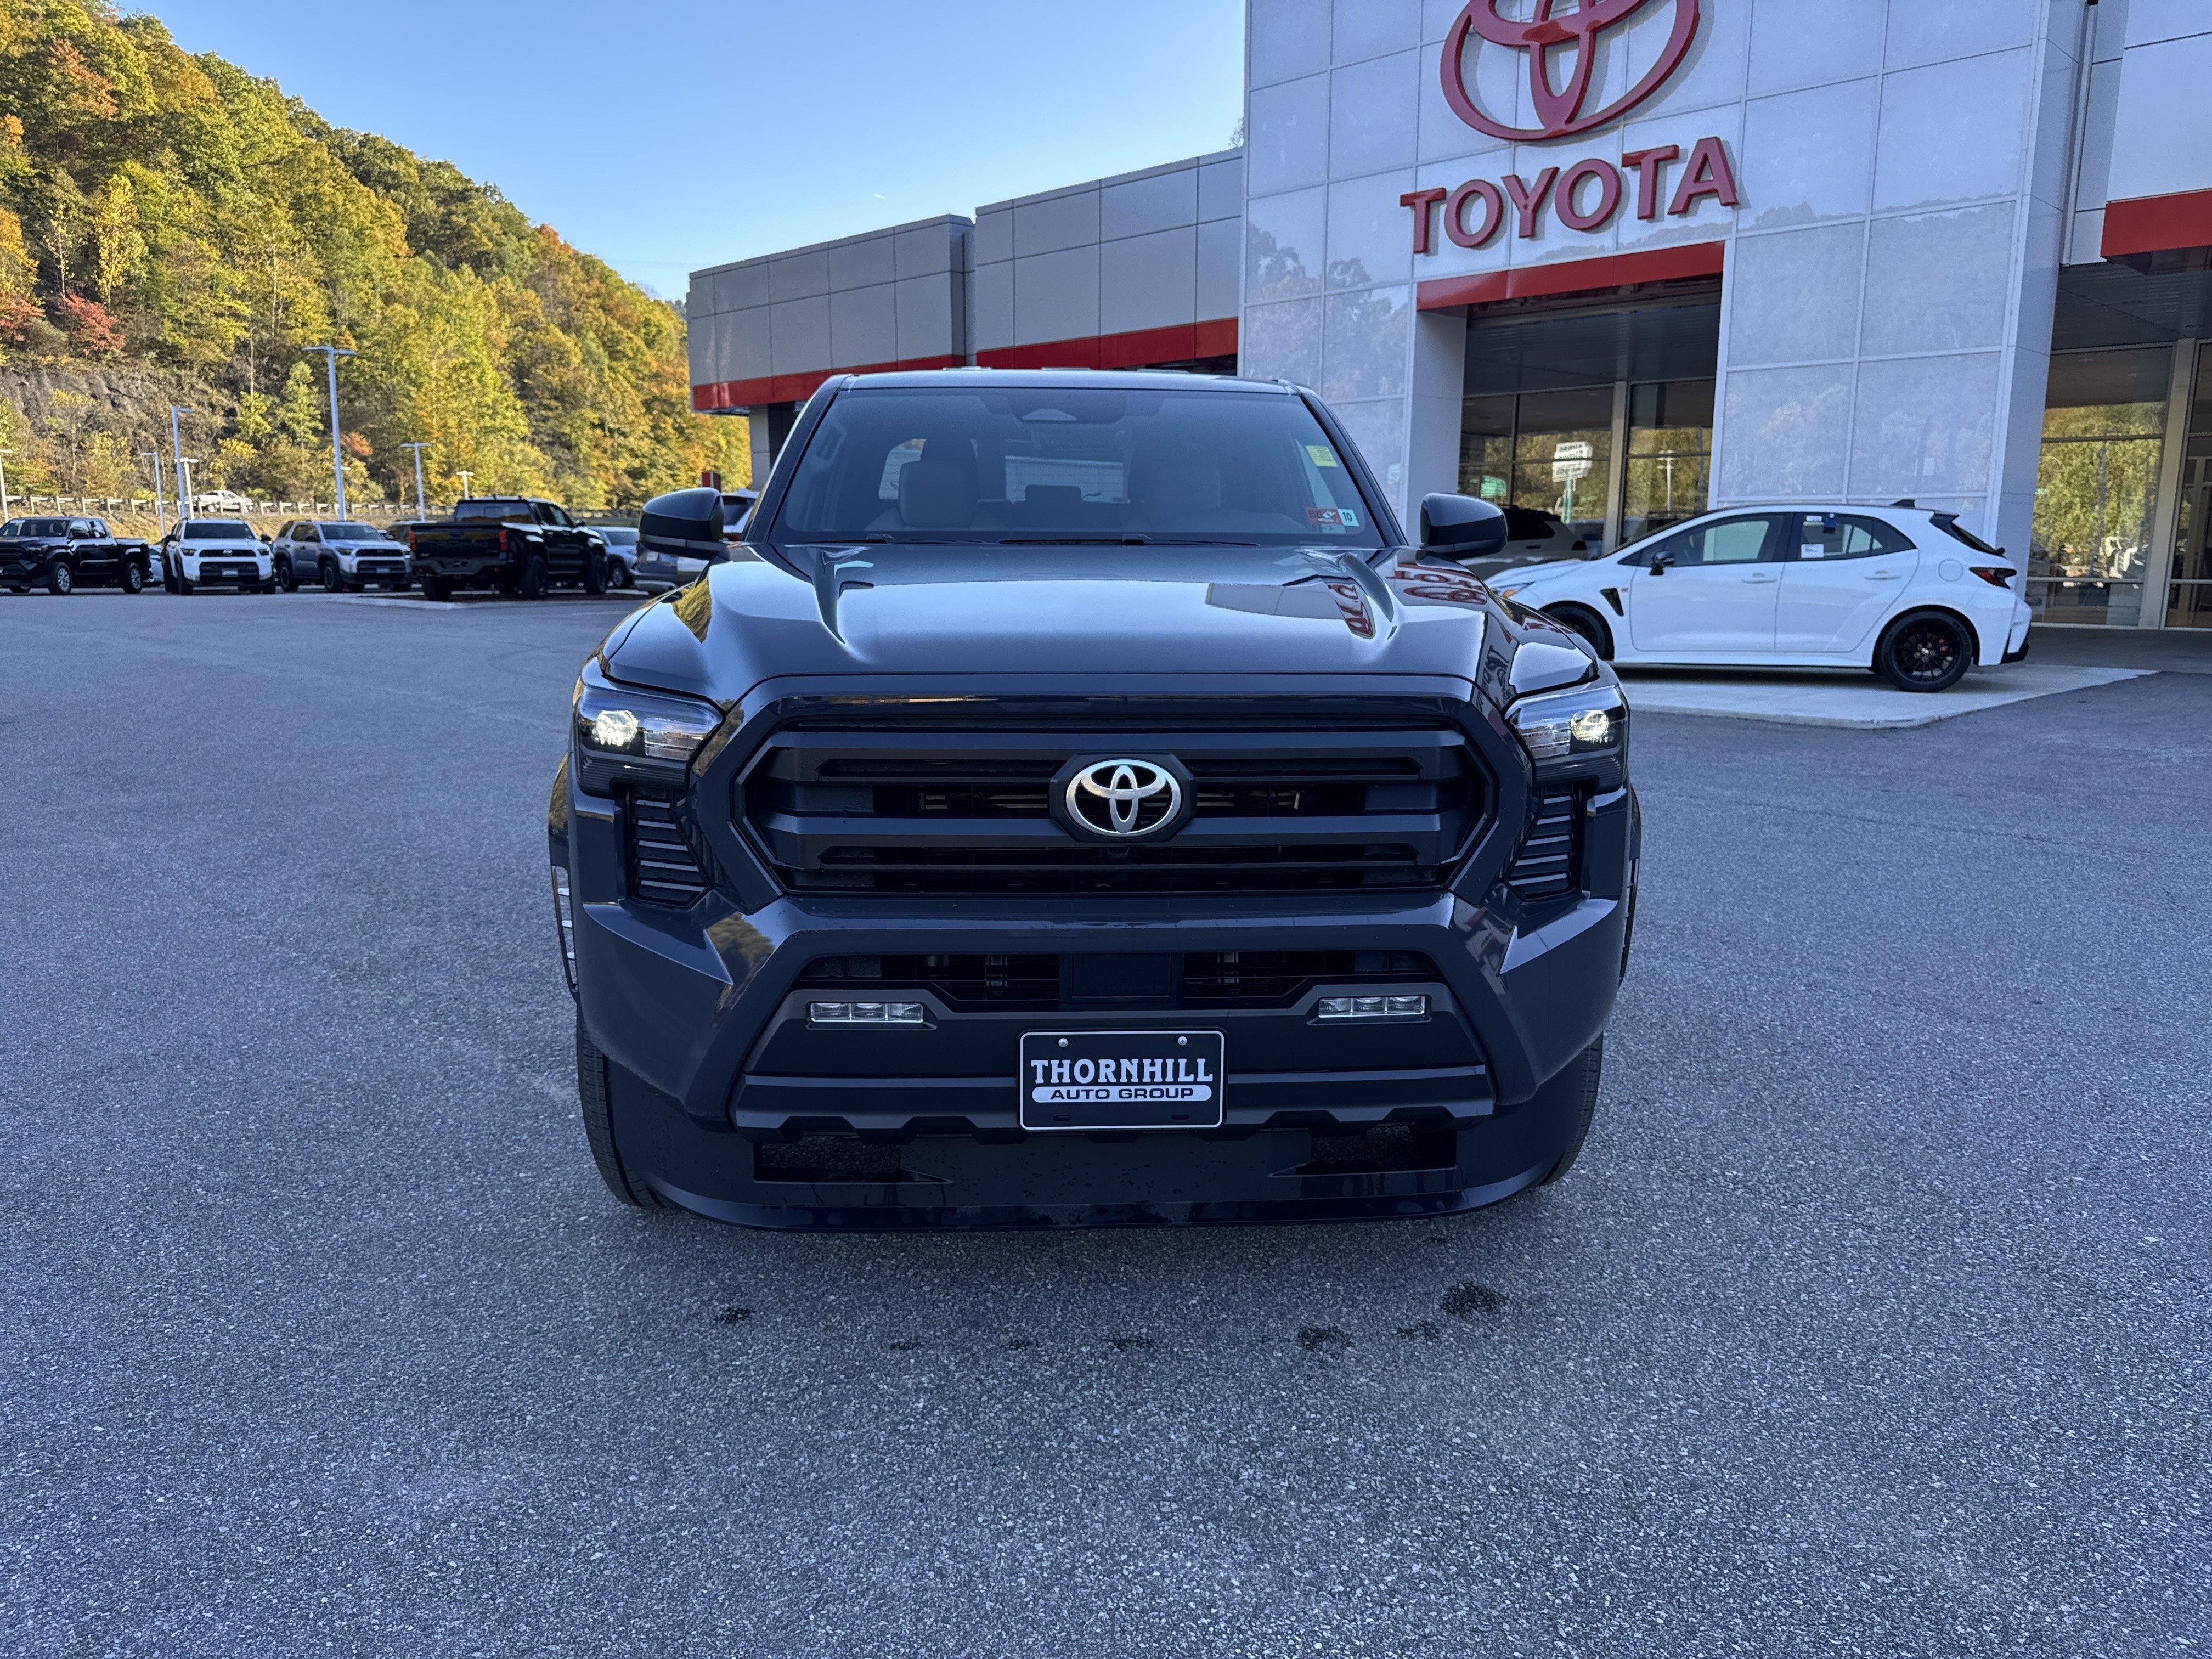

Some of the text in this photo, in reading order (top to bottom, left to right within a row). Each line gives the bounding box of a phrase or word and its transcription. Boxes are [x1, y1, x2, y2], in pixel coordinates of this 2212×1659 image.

[1400, 136, 1739, 254] TOYOTA
[1031, 1058, 1214, 1084] THORNHILL
[1050, 1088, 1194, 1100] AUTO GROUP
